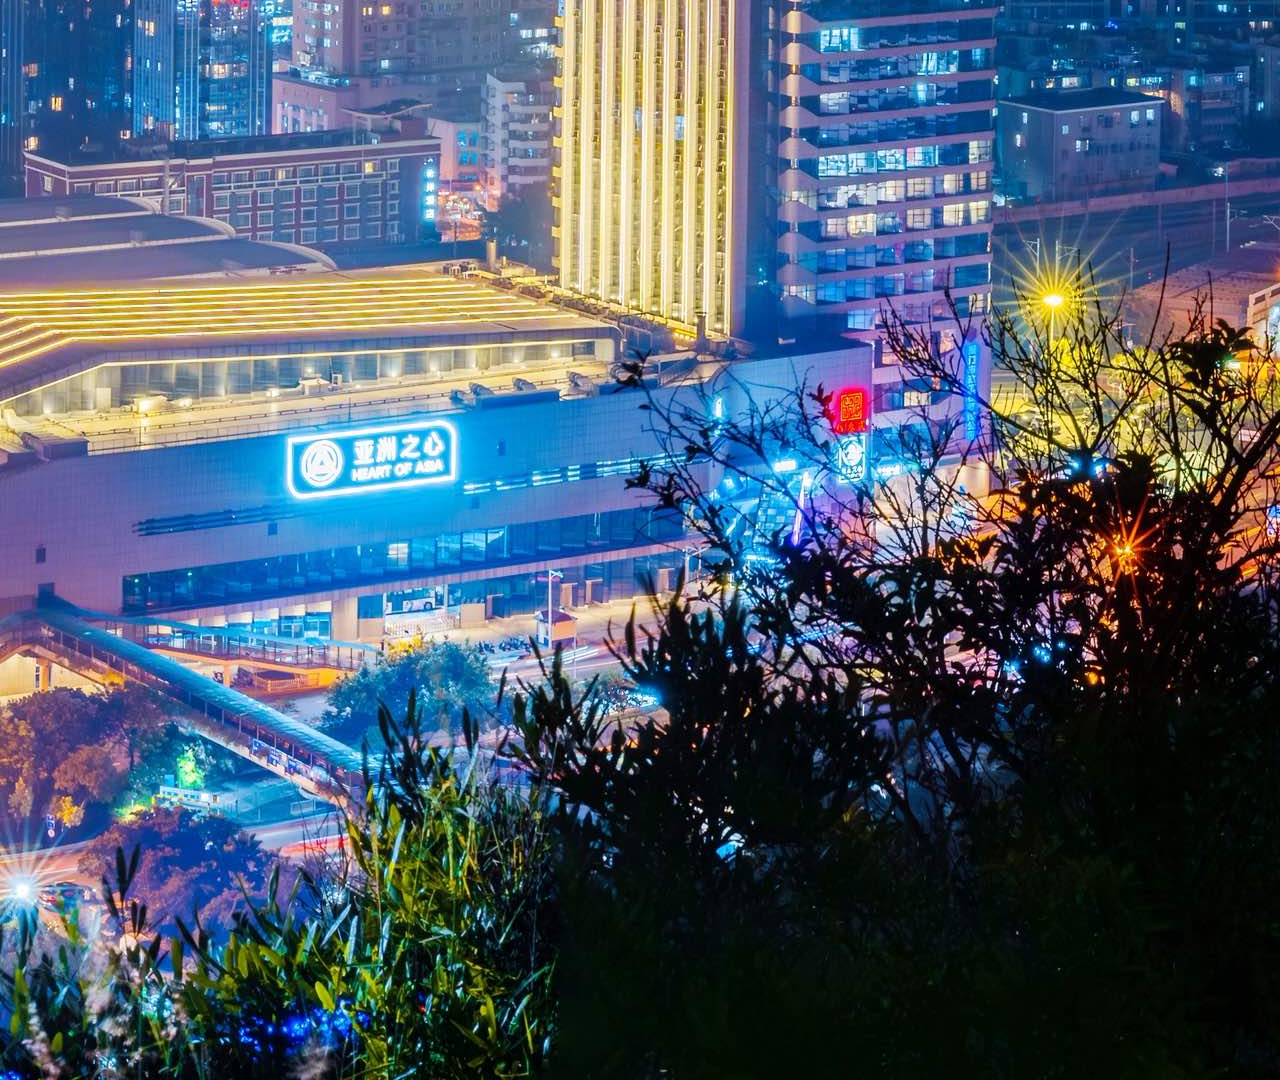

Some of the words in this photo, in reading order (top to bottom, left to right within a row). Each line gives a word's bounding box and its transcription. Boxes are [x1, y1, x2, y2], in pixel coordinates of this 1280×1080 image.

[353, 431, 445, 466] 亚洲之心
[351, 464, 392, 482] HEART
[394, 462, 413, 476] OF
[414, 459, 444, 474] ASIA
